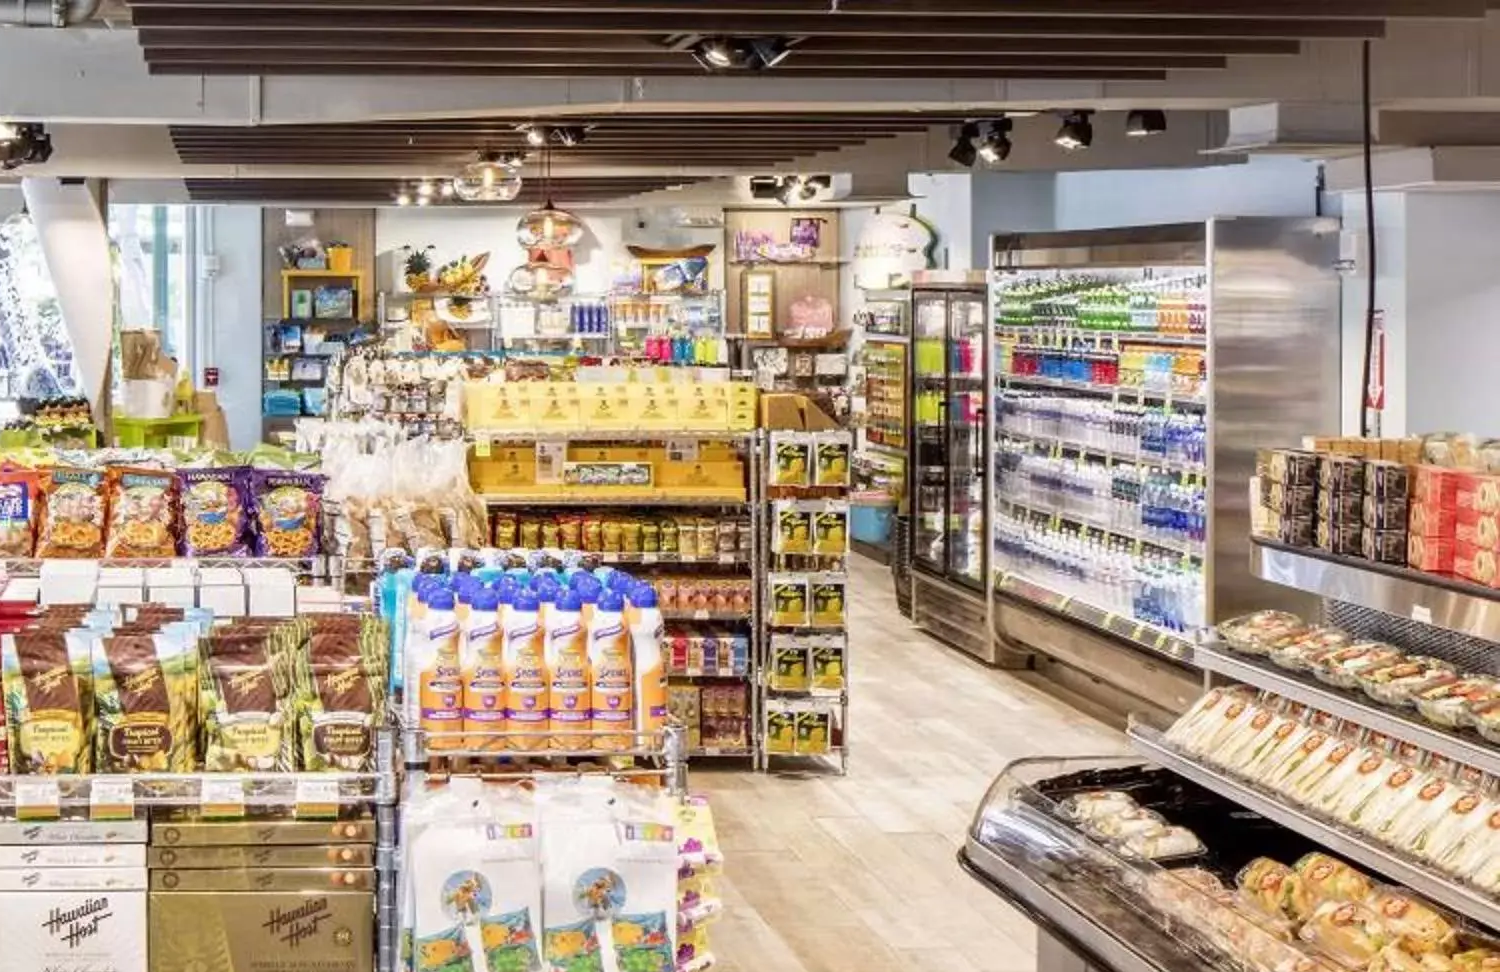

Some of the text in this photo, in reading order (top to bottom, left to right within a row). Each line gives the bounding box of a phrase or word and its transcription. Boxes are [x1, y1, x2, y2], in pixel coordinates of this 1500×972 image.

[42, 897, 108, 935] Hawaiian
[60, 912, 112, 948] Host
[262, 897, 328, 935] Hawaiian
[280, 914, 332, 950] Host
